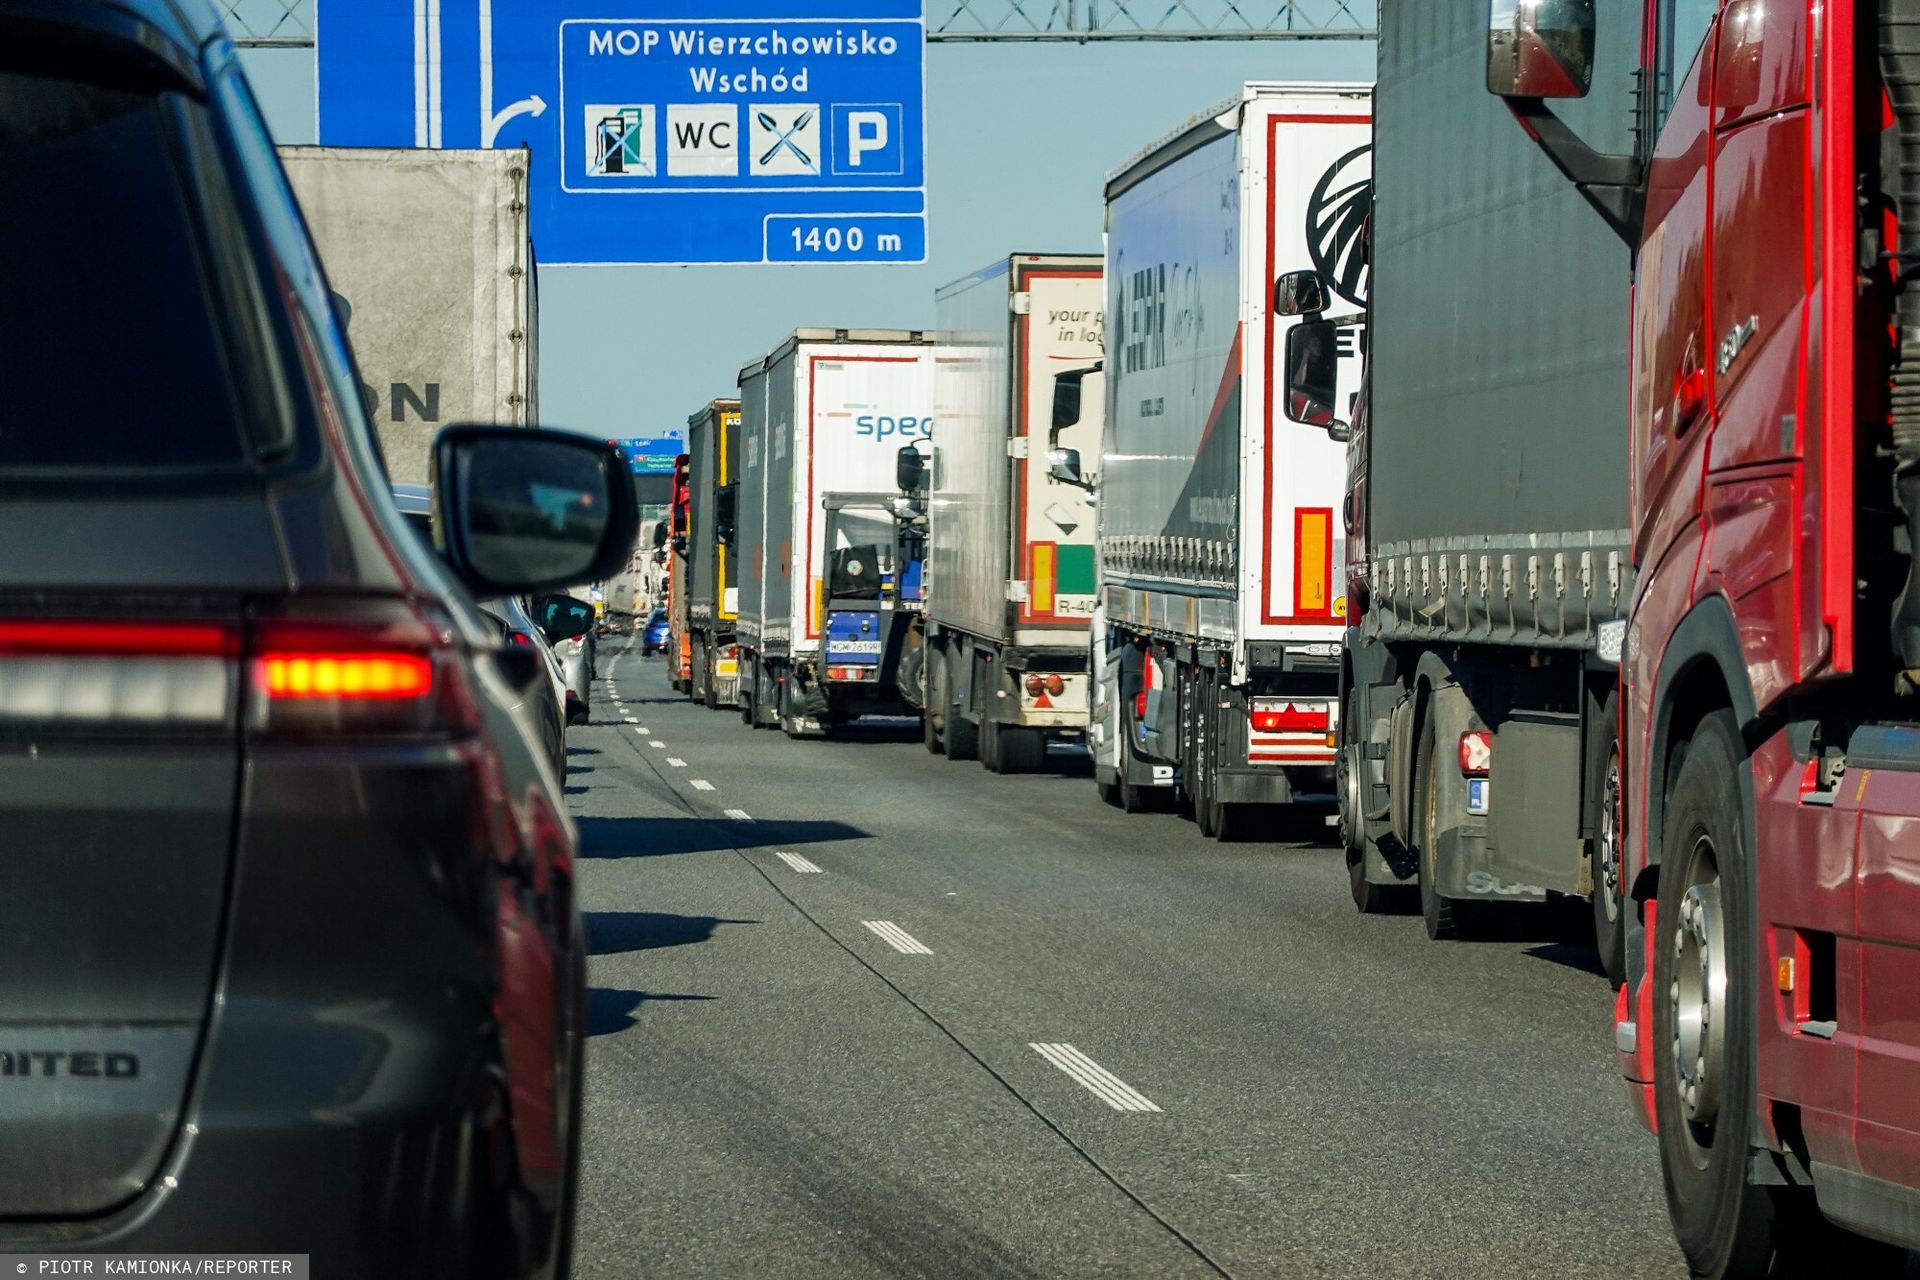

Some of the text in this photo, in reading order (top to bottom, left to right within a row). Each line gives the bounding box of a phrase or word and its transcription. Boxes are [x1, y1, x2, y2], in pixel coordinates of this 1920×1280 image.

[588, 29, 898, 56] MOP Wierzchowisko
[690, 67, 809, 94] Wschód
[675, 121, 731, 150] WC
[849, 112, 888, 166] P
[792, 227, 902, 252] 1400 m
[1048, 310, 1090, 325] your
[1058, 327, 1074, 341] in
